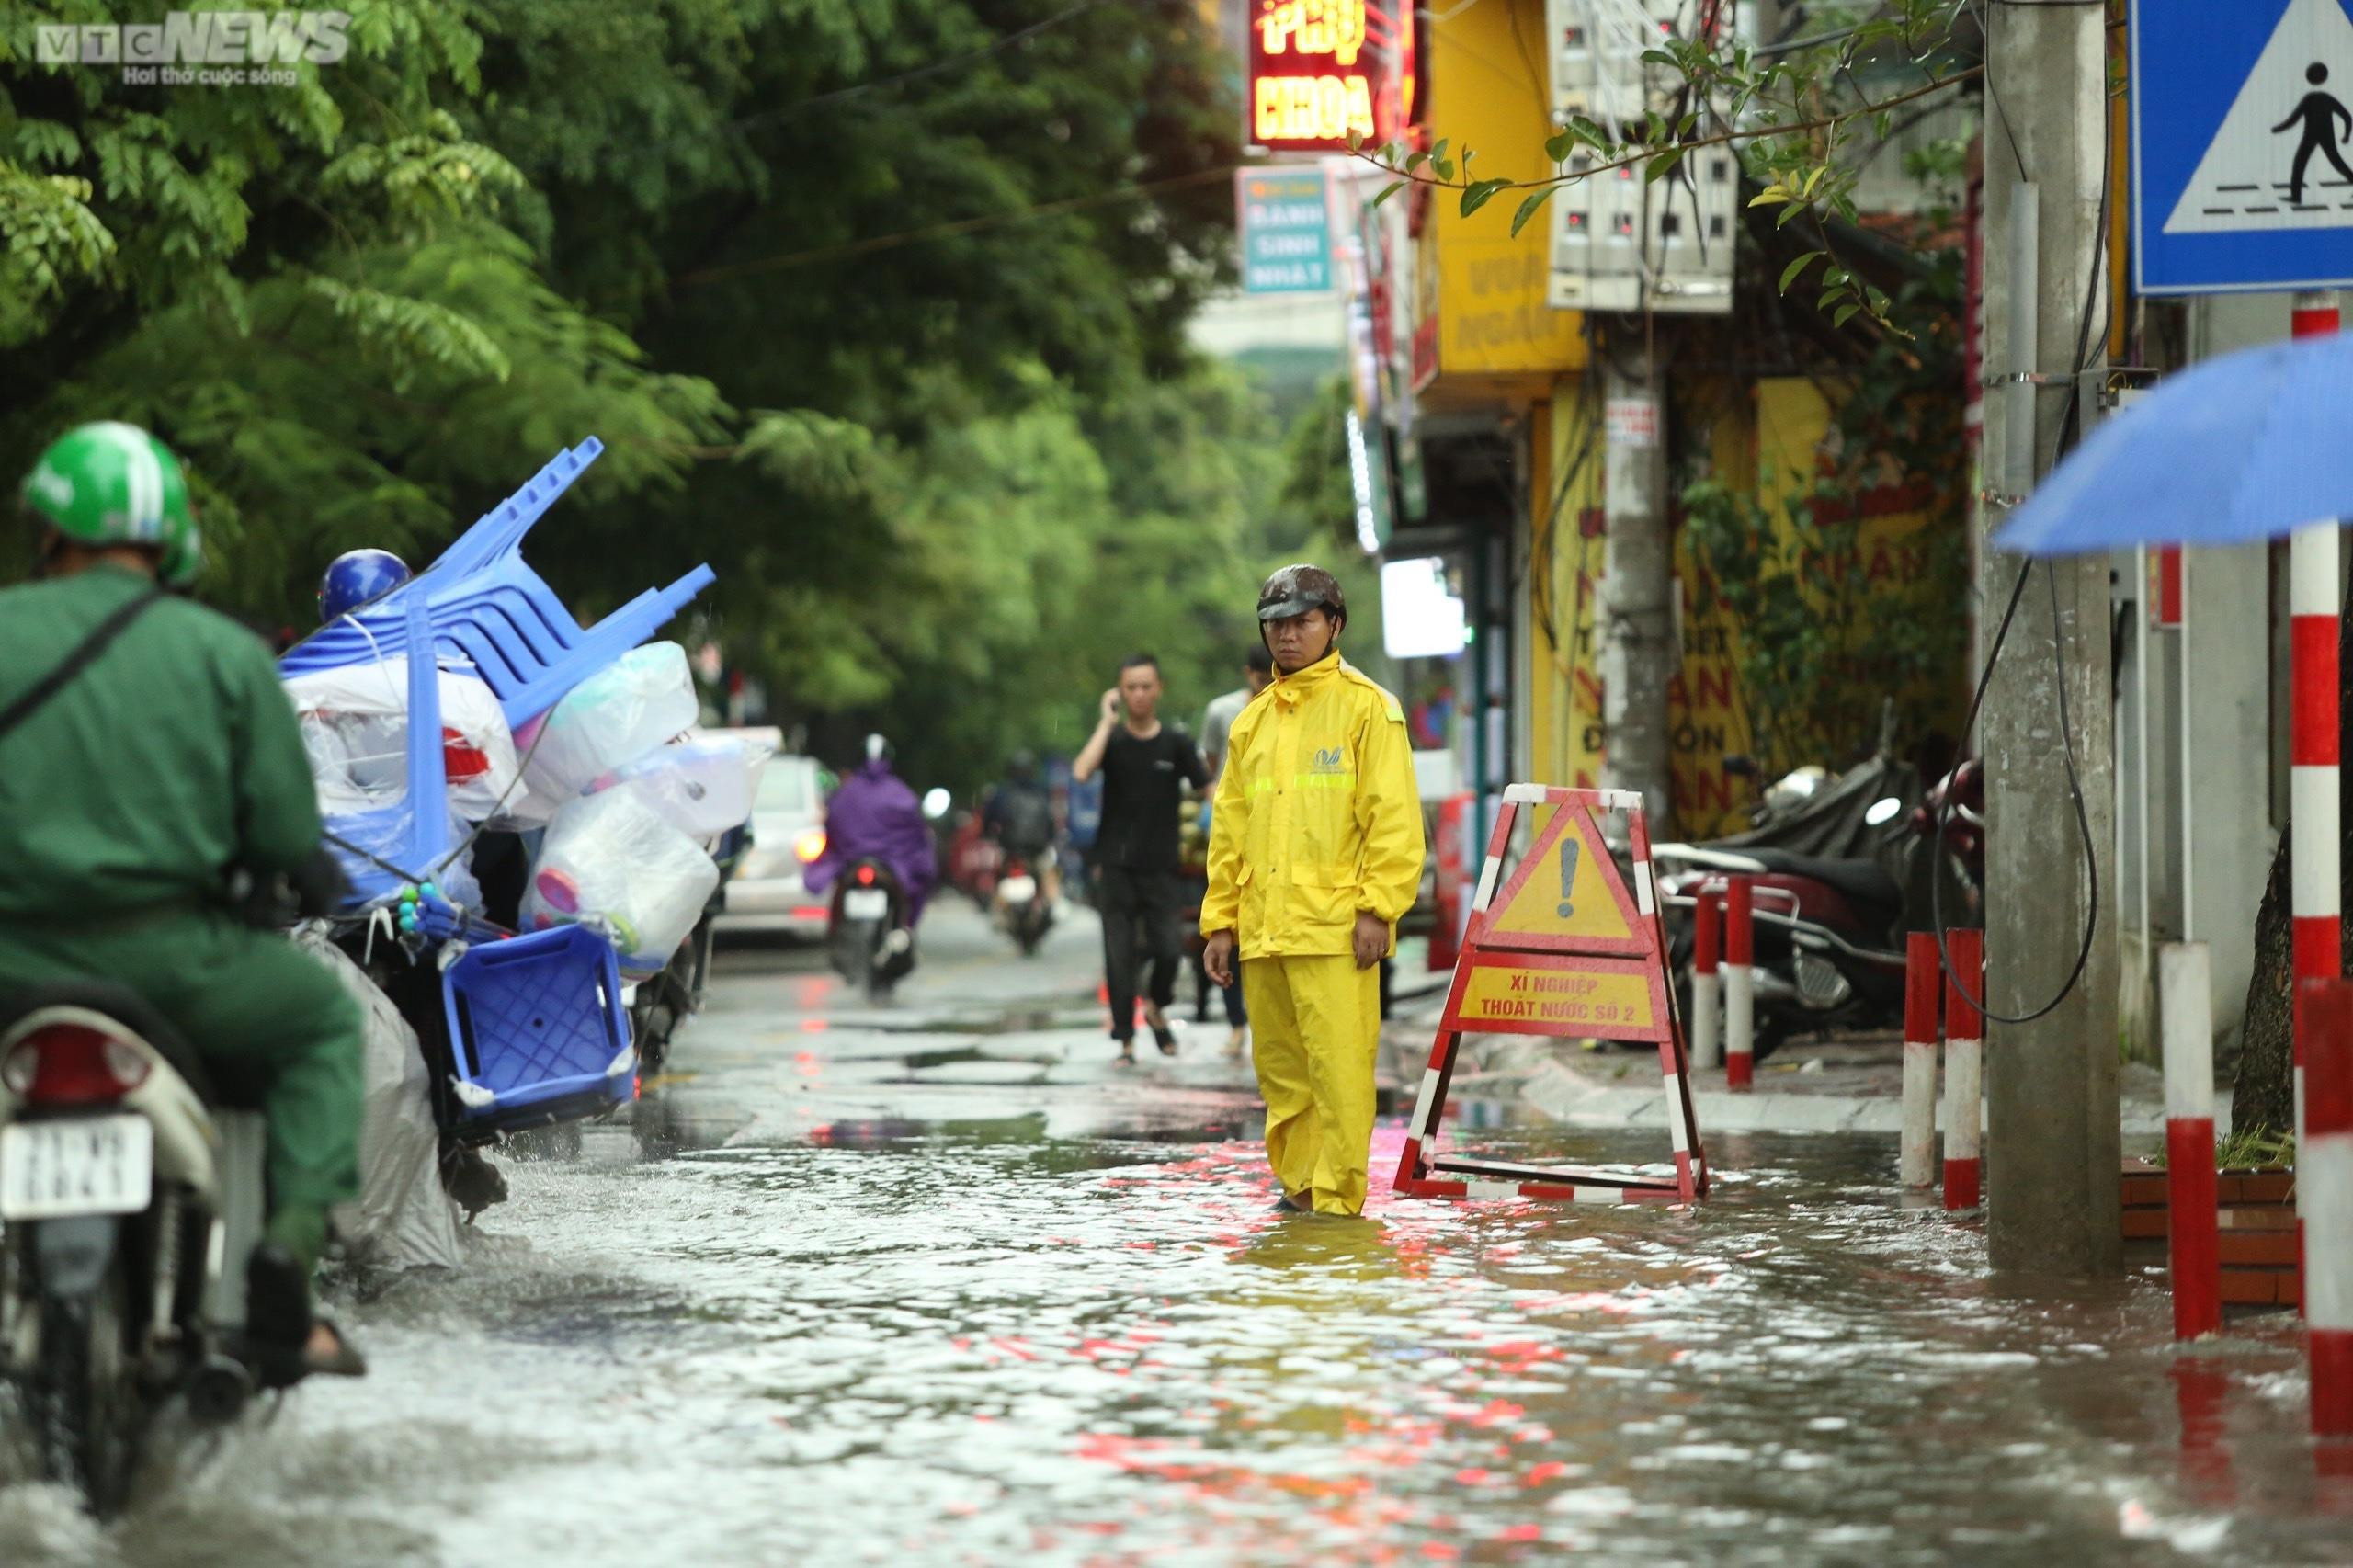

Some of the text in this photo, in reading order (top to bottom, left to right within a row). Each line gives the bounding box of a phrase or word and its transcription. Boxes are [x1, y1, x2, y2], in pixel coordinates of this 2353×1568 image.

[1256, 75, 1374, 139] KHOA
[1533, 974, 1599, 995] NGHIỆP
[1481, 995, 1635, 1022] THOÁT NƯỚC SỐ 2
